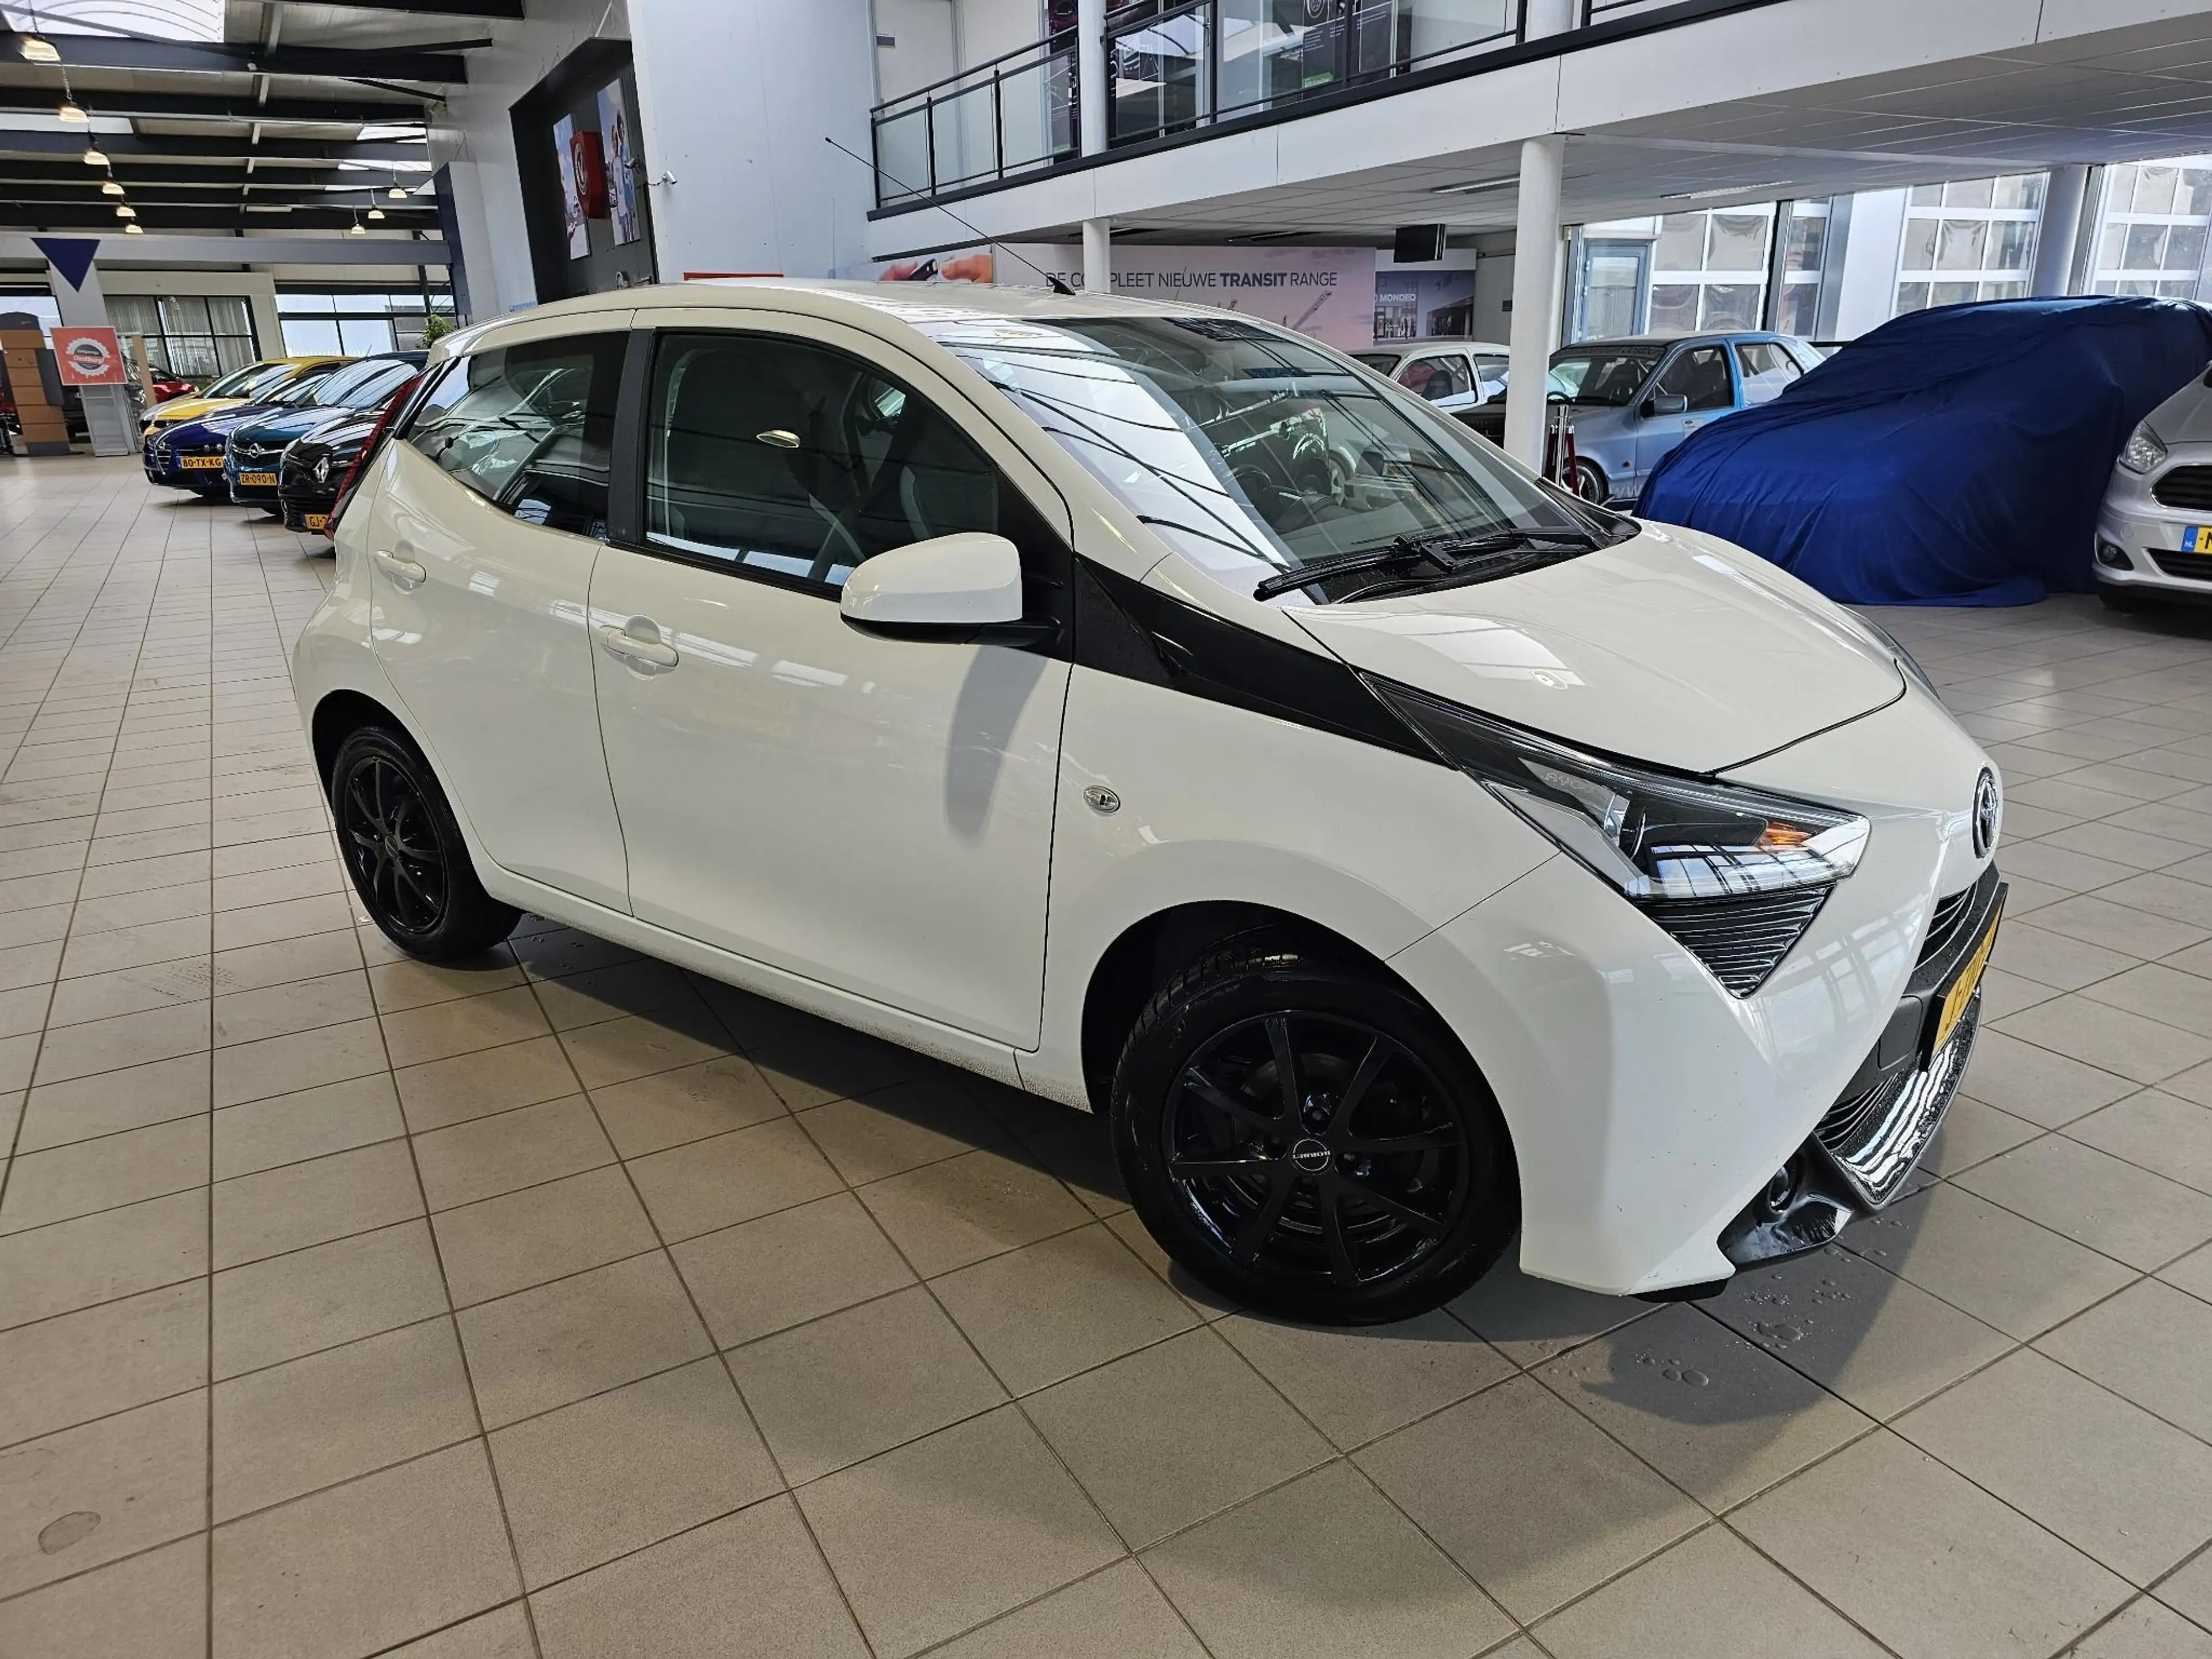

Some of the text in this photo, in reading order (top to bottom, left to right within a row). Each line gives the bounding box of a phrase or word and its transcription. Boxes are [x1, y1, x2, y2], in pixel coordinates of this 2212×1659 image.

[1070, 272, 1154, 287] CPLEET
[1158, 272, 1216, 287] NIEUWE
[1219, 272, 1287, 287] TRANSIT
[1290, 271, 1338, 286] RANGE
[1379, 293, 1416, 302] MONDEO
[183, 458, 222, 467] 80-TX-KG
[241, 474, 276, 484] ZR-090-N
